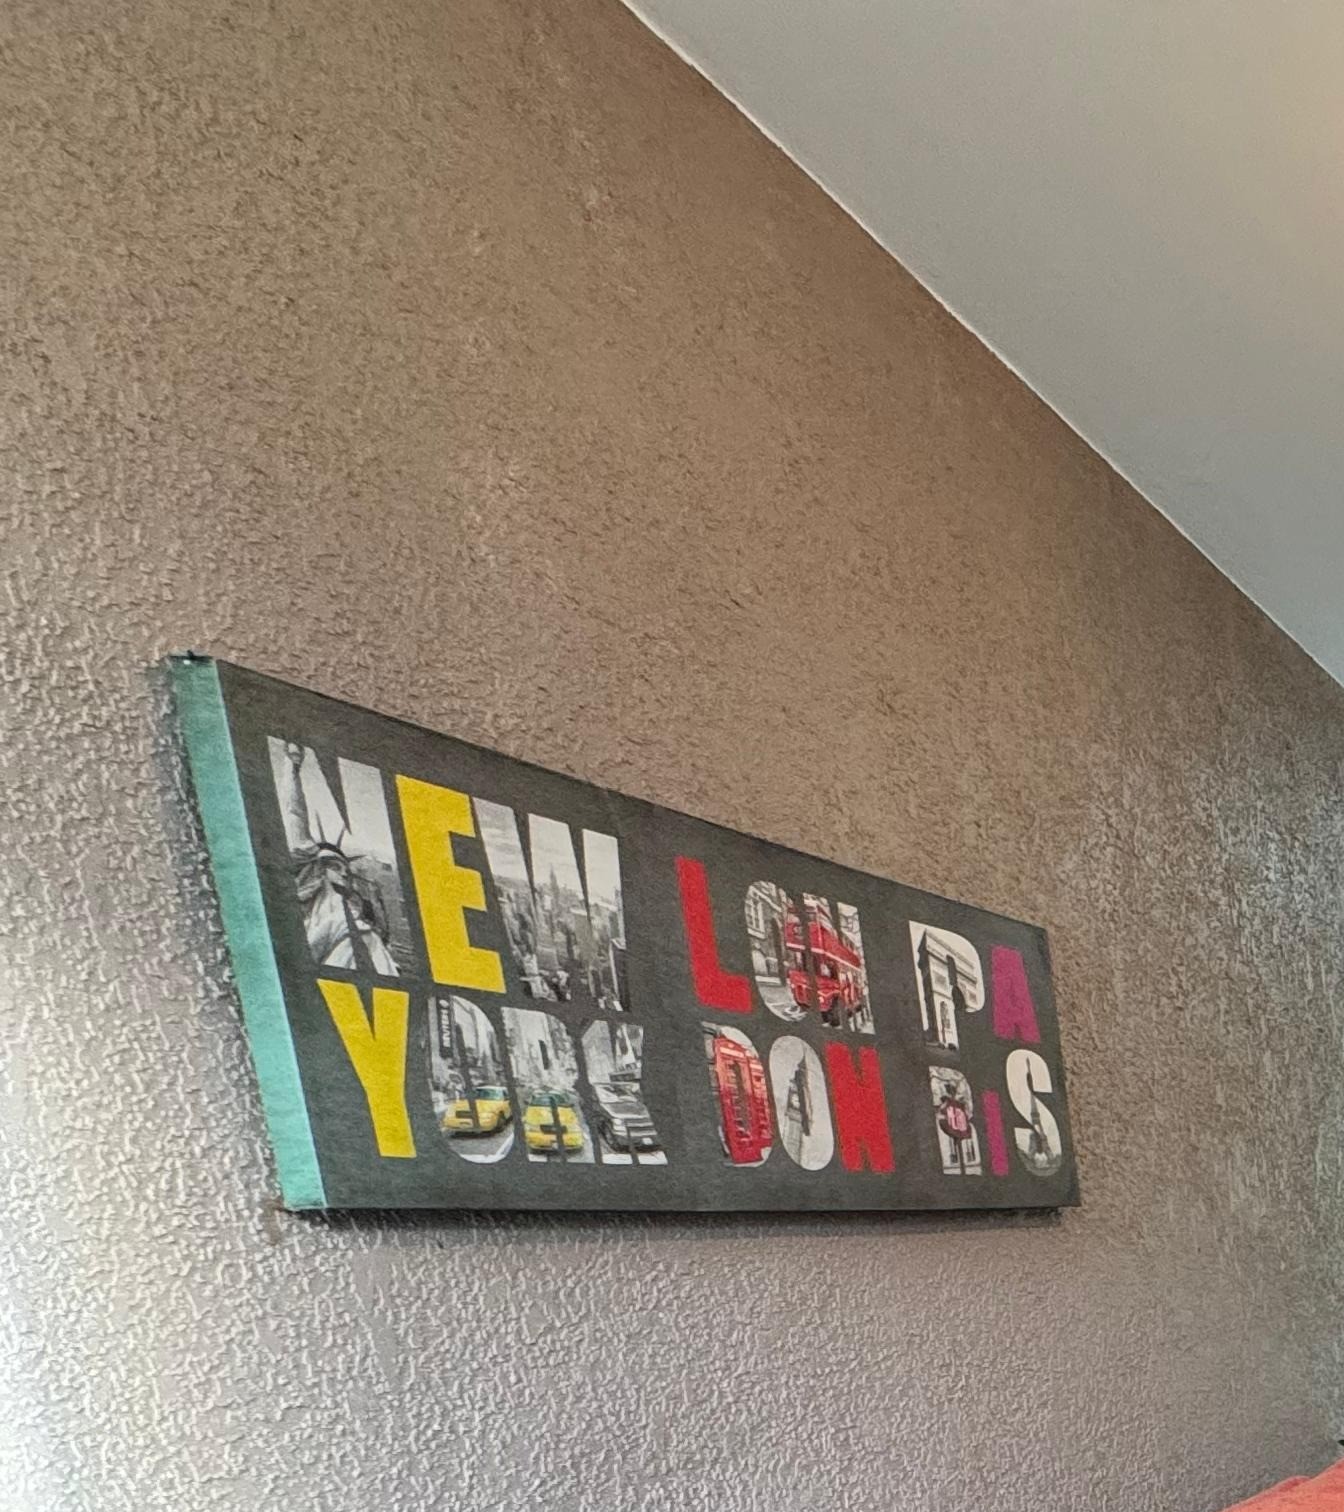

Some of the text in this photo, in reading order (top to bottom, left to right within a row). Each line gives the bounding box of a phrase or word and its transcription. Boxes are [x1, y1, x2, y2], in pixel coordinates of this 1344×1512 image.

[266, 734, 630, 1013] NEW
[675, 855, 878, 1036] LON
[909, 920, 1041, 1051] PA
[318, 978, 669, 1166] YORK
[701, 1020, 896, 1174] DON
[928, 1050, 1062, 1177] RIS
